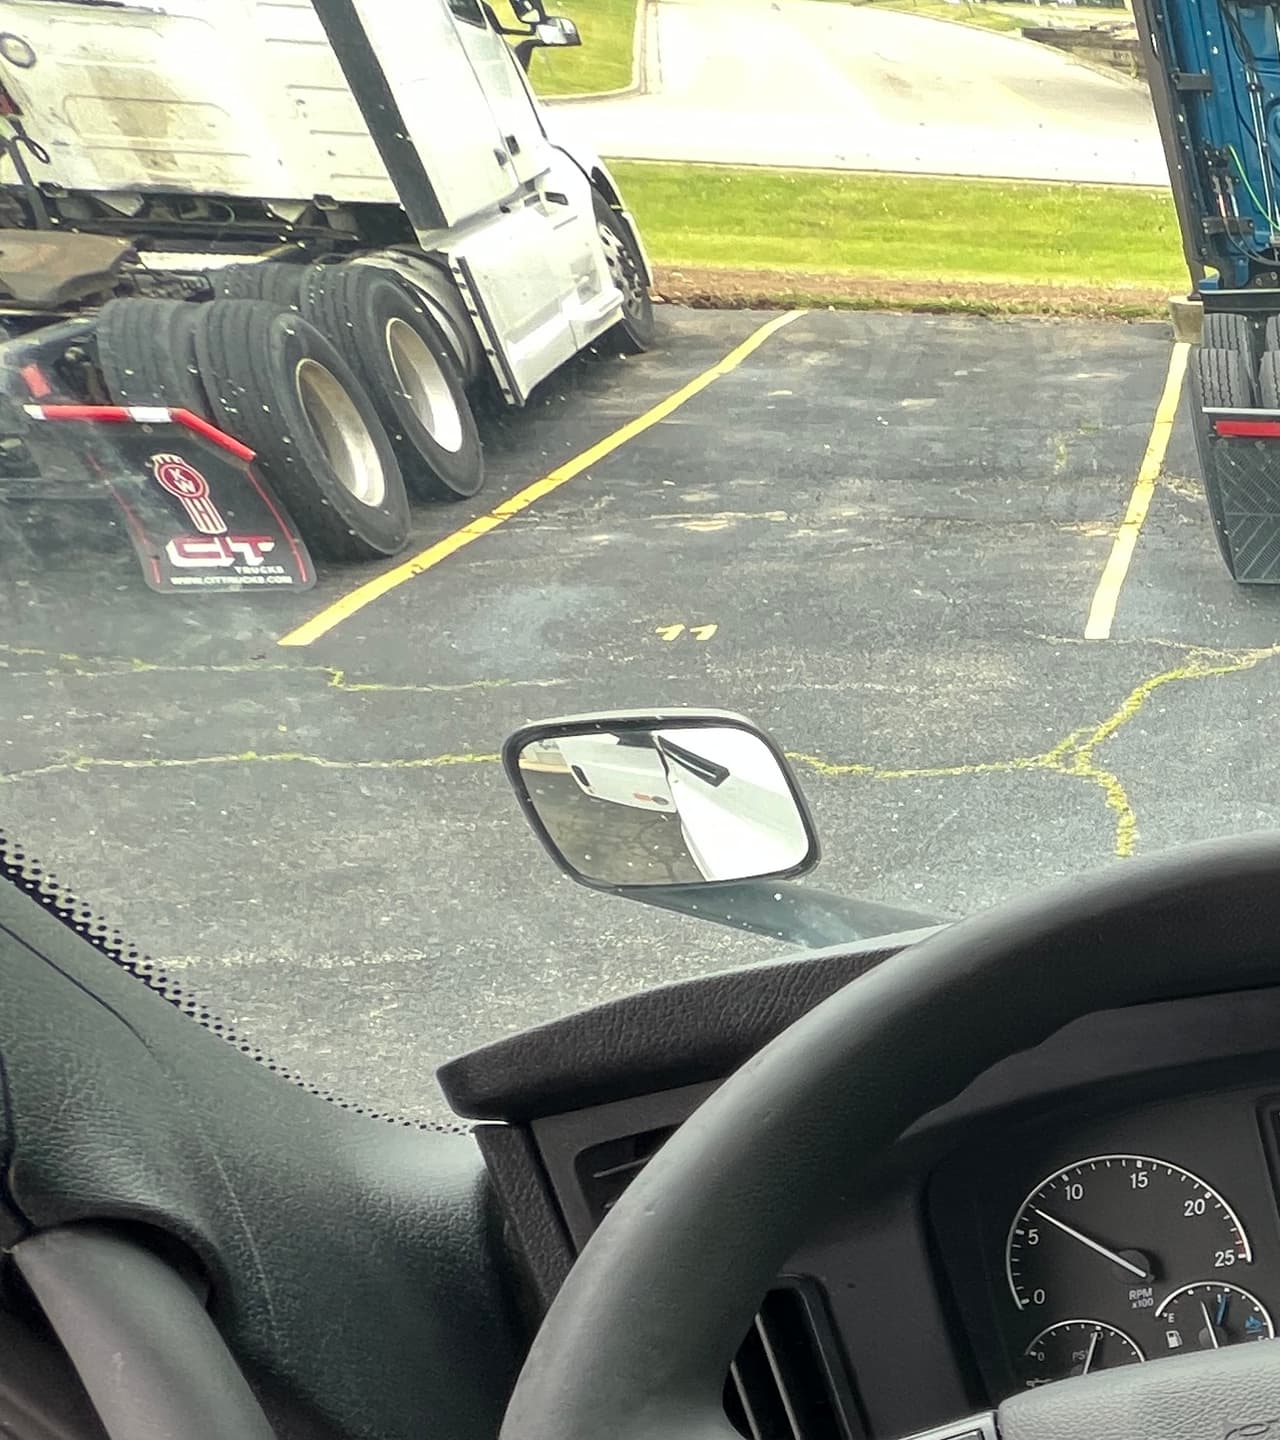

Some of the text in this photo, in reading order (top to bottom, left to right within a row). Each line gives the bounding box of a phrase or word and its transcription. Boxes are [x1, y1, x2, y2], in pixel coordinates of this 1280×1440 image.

[234, 566, 285, 575] TRUCKS
[655, 624, 718, 641] 11
[1130, 1172, 1149, 1189] 15
[1064, 1183, 1084, 1200] 10
[1183, 1199, 1206, 1217] 20
[1027, 1228, 1040, 1246] 5
[1214, 1250, 1236, 1268] 25
[1033, 1289, 1046, 1305] 0
[1129, 1288, 1153, 1301] RPM
[1167, 1313, 1176, 1324] E
